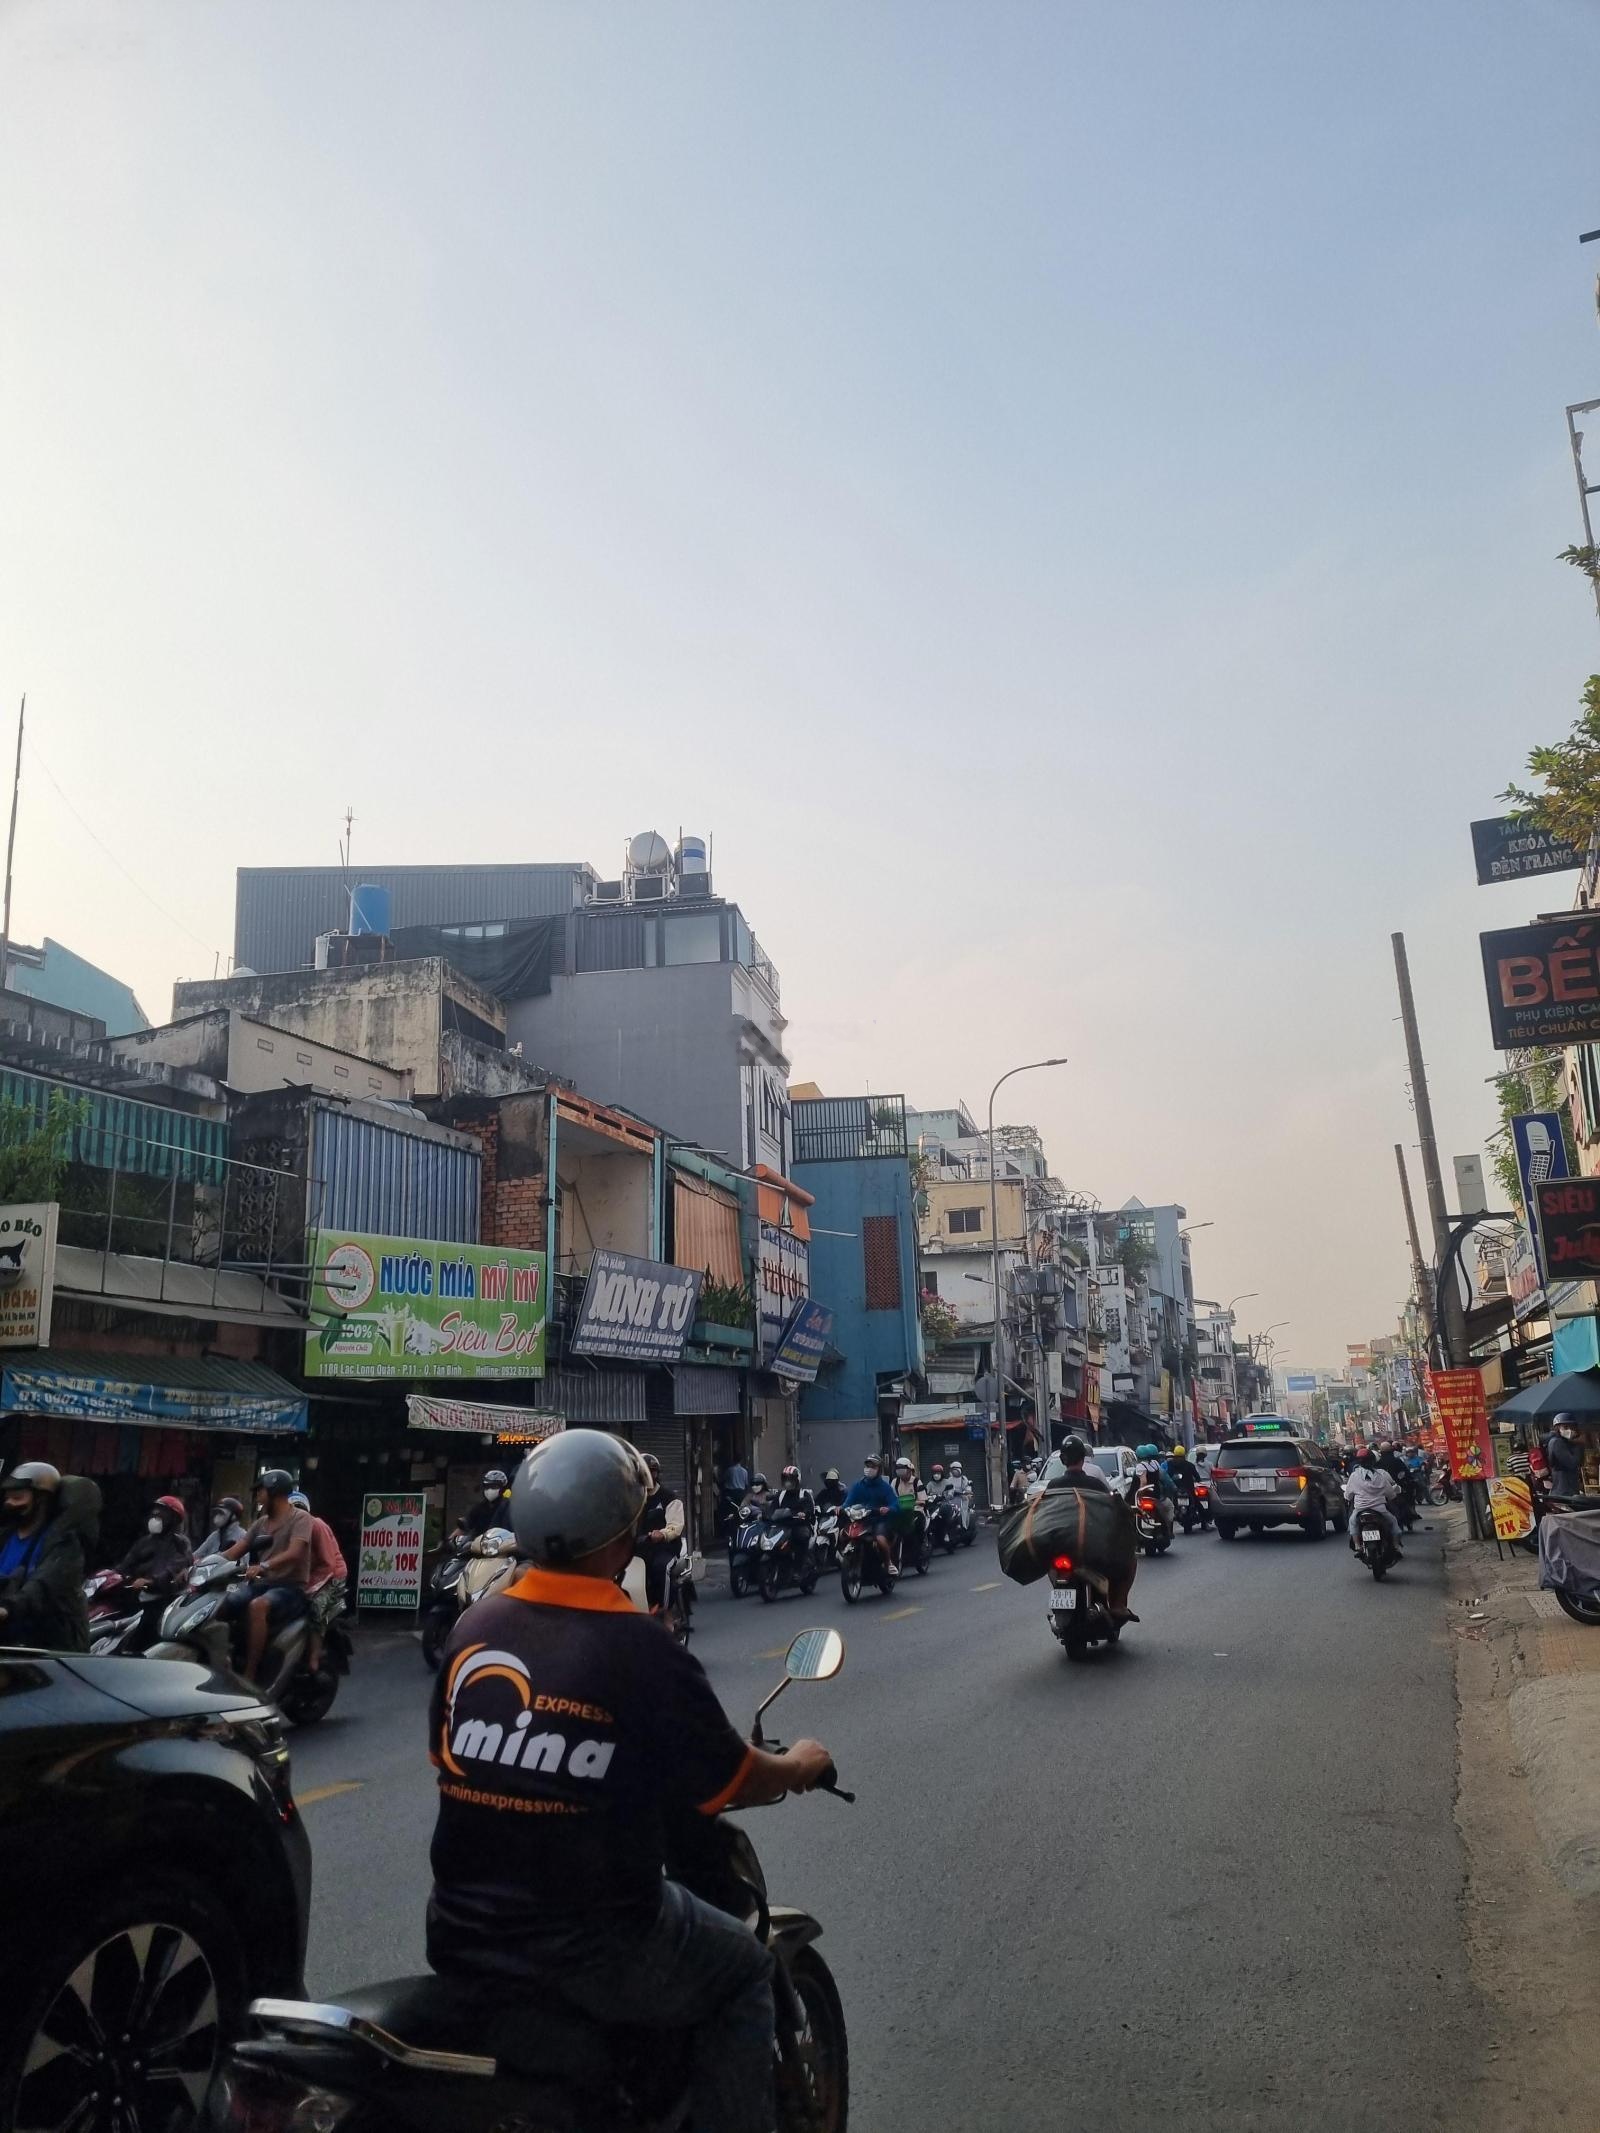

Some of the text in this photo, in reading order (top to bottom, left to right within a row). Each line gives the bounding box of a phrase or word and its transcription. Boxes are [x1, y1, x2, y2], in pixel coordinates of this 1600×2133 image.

[1508, 833, 1547, 853] KHÓA
[1490, 856, 1521, 876] ĐÈN
[1523, 848, 1574, 871] TRANG
[1498, 924, 1600, 1008] BẾ
[1515, 1010, 1541, 1022] PHỤ
[1544, 1004, 1575, 1020] KIỆN
[1507, 1025, 1536, 1040] TIÊU
[14, 1218, 42, 1237] BÉO
[380, 1250, 433, 1296] NƯỚC
[438, 1255, 476, 1300] MÍA
[480, 1260, 509, 1302] MỸ
[513, 1263, 540, 1304] MỸ
[588, 1270, 660, 1328] MINH
[657, 1274, 694, 1331] TÚ
[341, 1323, 373, 1339] 100%
[440, 1311, 539, 1360] Siêu Bọt
[356, 1364, 374, 1376] Long
[362, 1527, 419, 1548] NƯỚC MÍA
[1498, 1519, 1516, 1536] 7K
[395, 1552, 418, 1572] 10K
[534, 1694, 614, 1723] EXPRESS
[451, 1710, 616, 1780] mina
